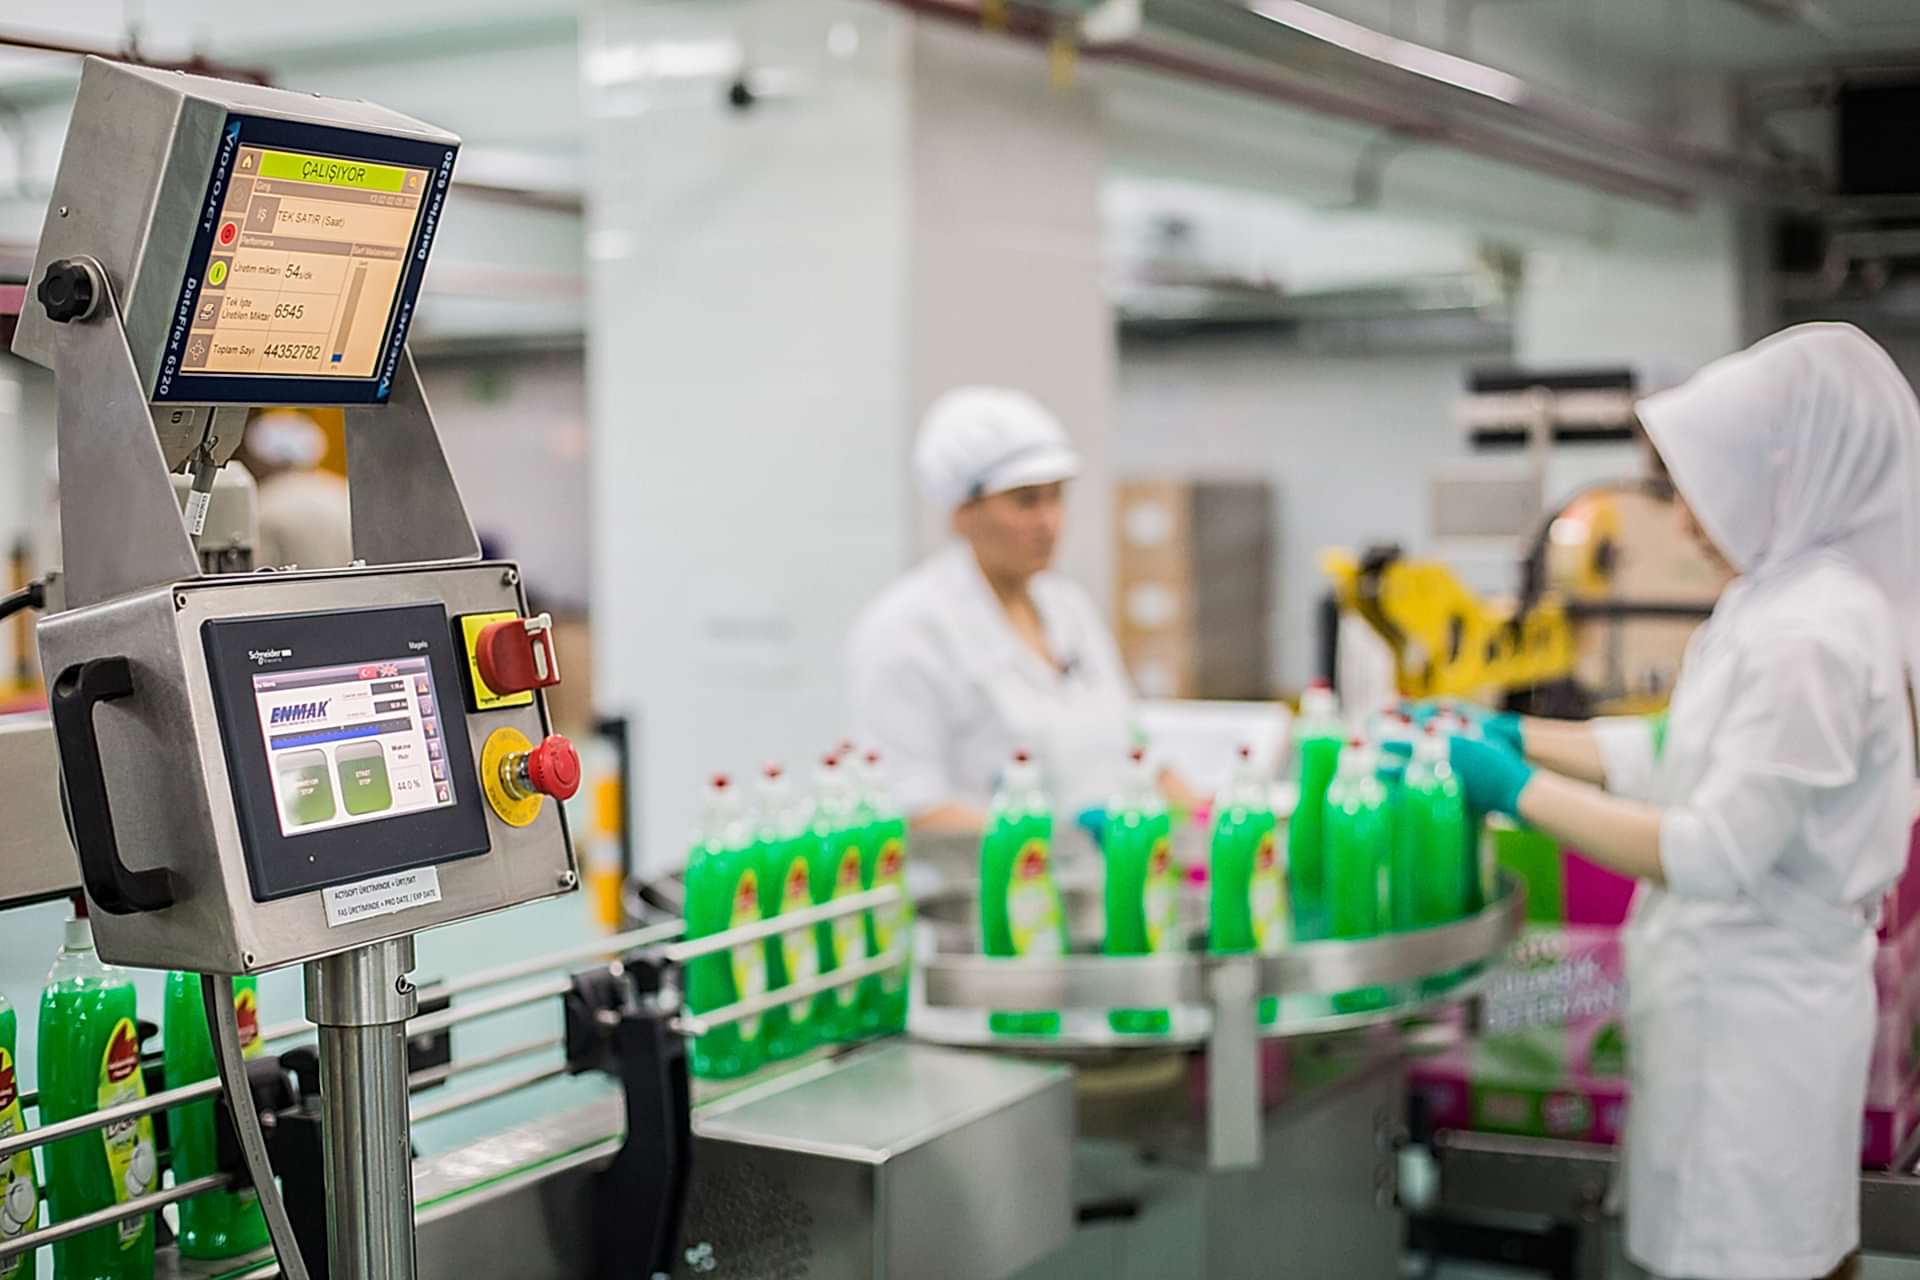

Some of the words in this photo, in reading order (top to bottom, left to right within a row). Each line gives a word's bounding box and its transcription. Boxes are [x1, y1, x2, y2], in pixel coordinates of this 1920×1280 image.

[203, 132, 235, 232] VIDEOJET
[302, 161, 366, 183] ÇALIŞIYOR
[417, 193, 443, 260] DataFlex
[437, 151, 453, 189] 6320
[277, 210, 293, 223] TEK
[292, 212, 321, 226] SATIR
[226, 297, 238, 307] Tek
[274, 303, 305, 320] 6545
[171, 278, 197, 351] DataFlex
[212, 344, 238, 355] Toplam
[263, 343, 321, 360] 44352782
[383, 301, 411, 387] VIDEOJET
[160, 355, 177, 395] 6320
[270, 700, 329, 724] ENMAK
[396, 895, 409, 906] DATE
